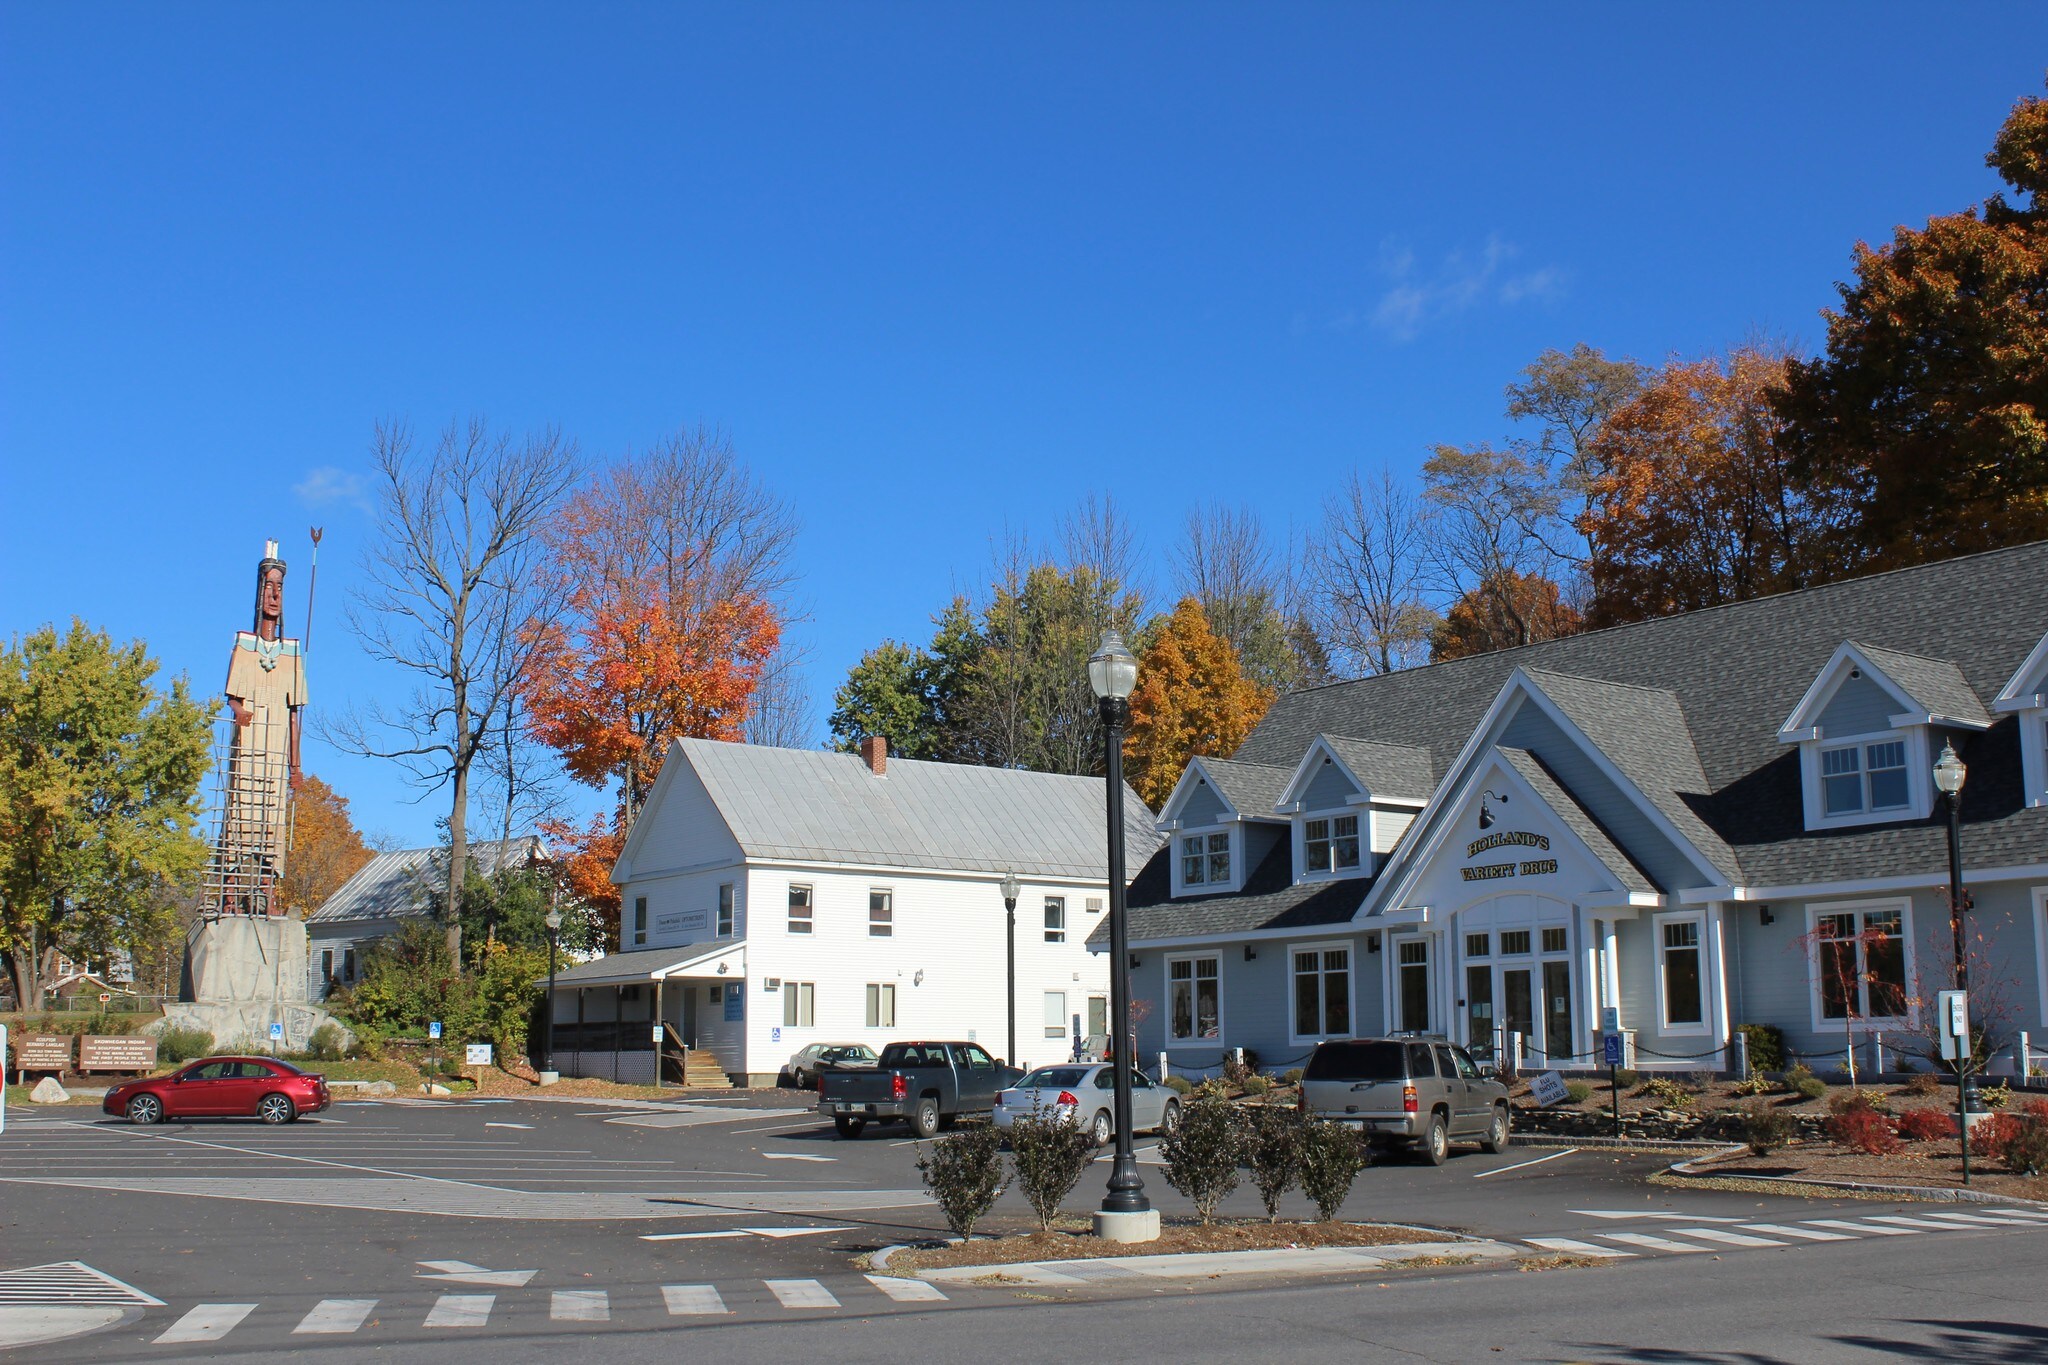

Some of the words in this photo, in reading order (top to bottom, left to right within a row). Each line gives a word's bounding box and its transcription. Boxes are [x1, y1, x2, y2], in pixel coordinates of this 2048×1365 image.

[1467, 832, 1549, 858] HOLLAND'S
[1461, 863, 1516, 881] VARIETY
[1520, 859, 1558, 876] DRUG
[1539, 1081, 1558, 1093] SHOTS
[1540, 1077, 1550, 1085] FLU
[1541, 1088, 1566, 1104] AVAILABLE
